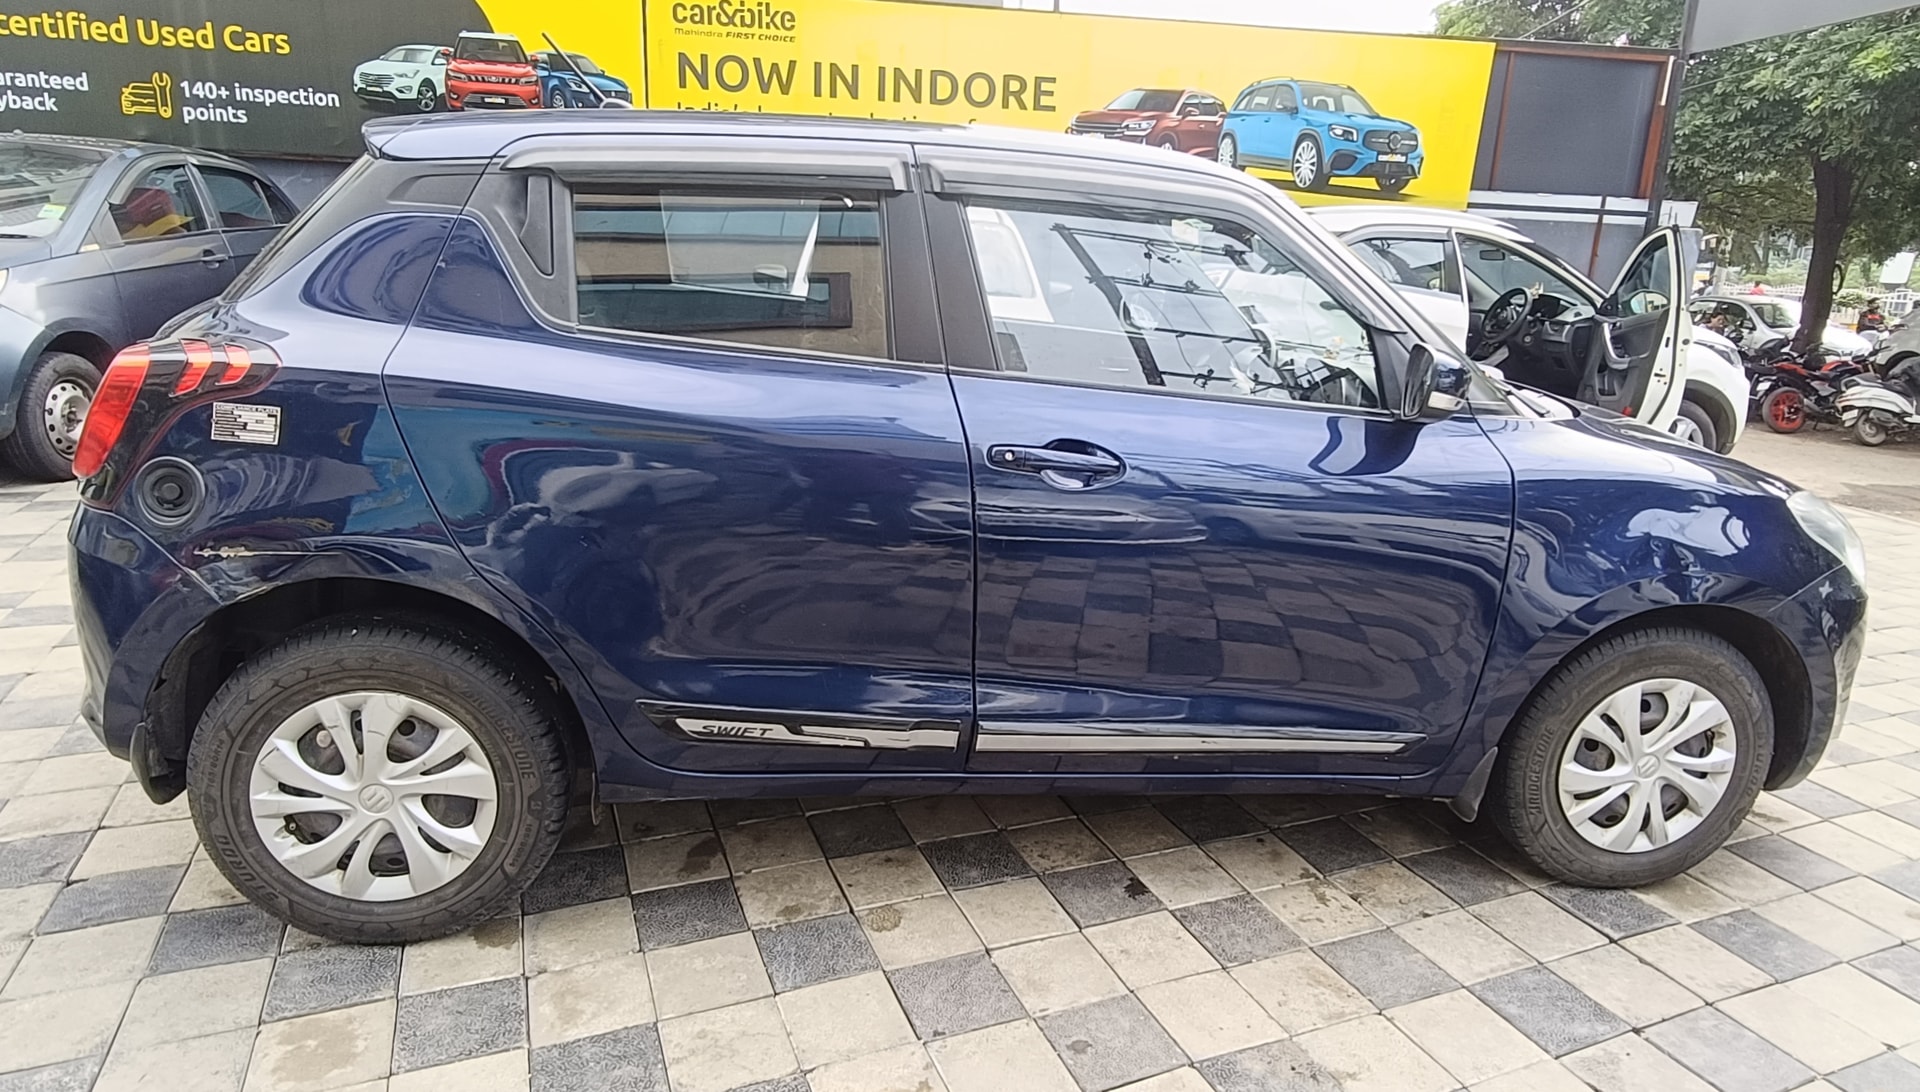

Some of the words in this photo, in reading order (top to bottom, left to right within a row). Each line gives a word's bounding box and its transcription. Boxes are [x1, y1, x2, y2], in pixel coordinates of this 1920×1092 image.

[136, 18, 215, 50] Used
[223, 24, 291, 55] Cars
[725, 31, 756, 40] FIRST
[758, 34, 797, 43] CHOICE
[179, 80, 230, 100] 140+
[234, 82, 341, 108] inspection
[677, 51, 797, 96] NOW
[813, 61, 859, 100] IN
[877, 66, 1057, 113] INDORE
[182, 103, 249, 125] points
[702, 725, 774, 737] SWIFT
